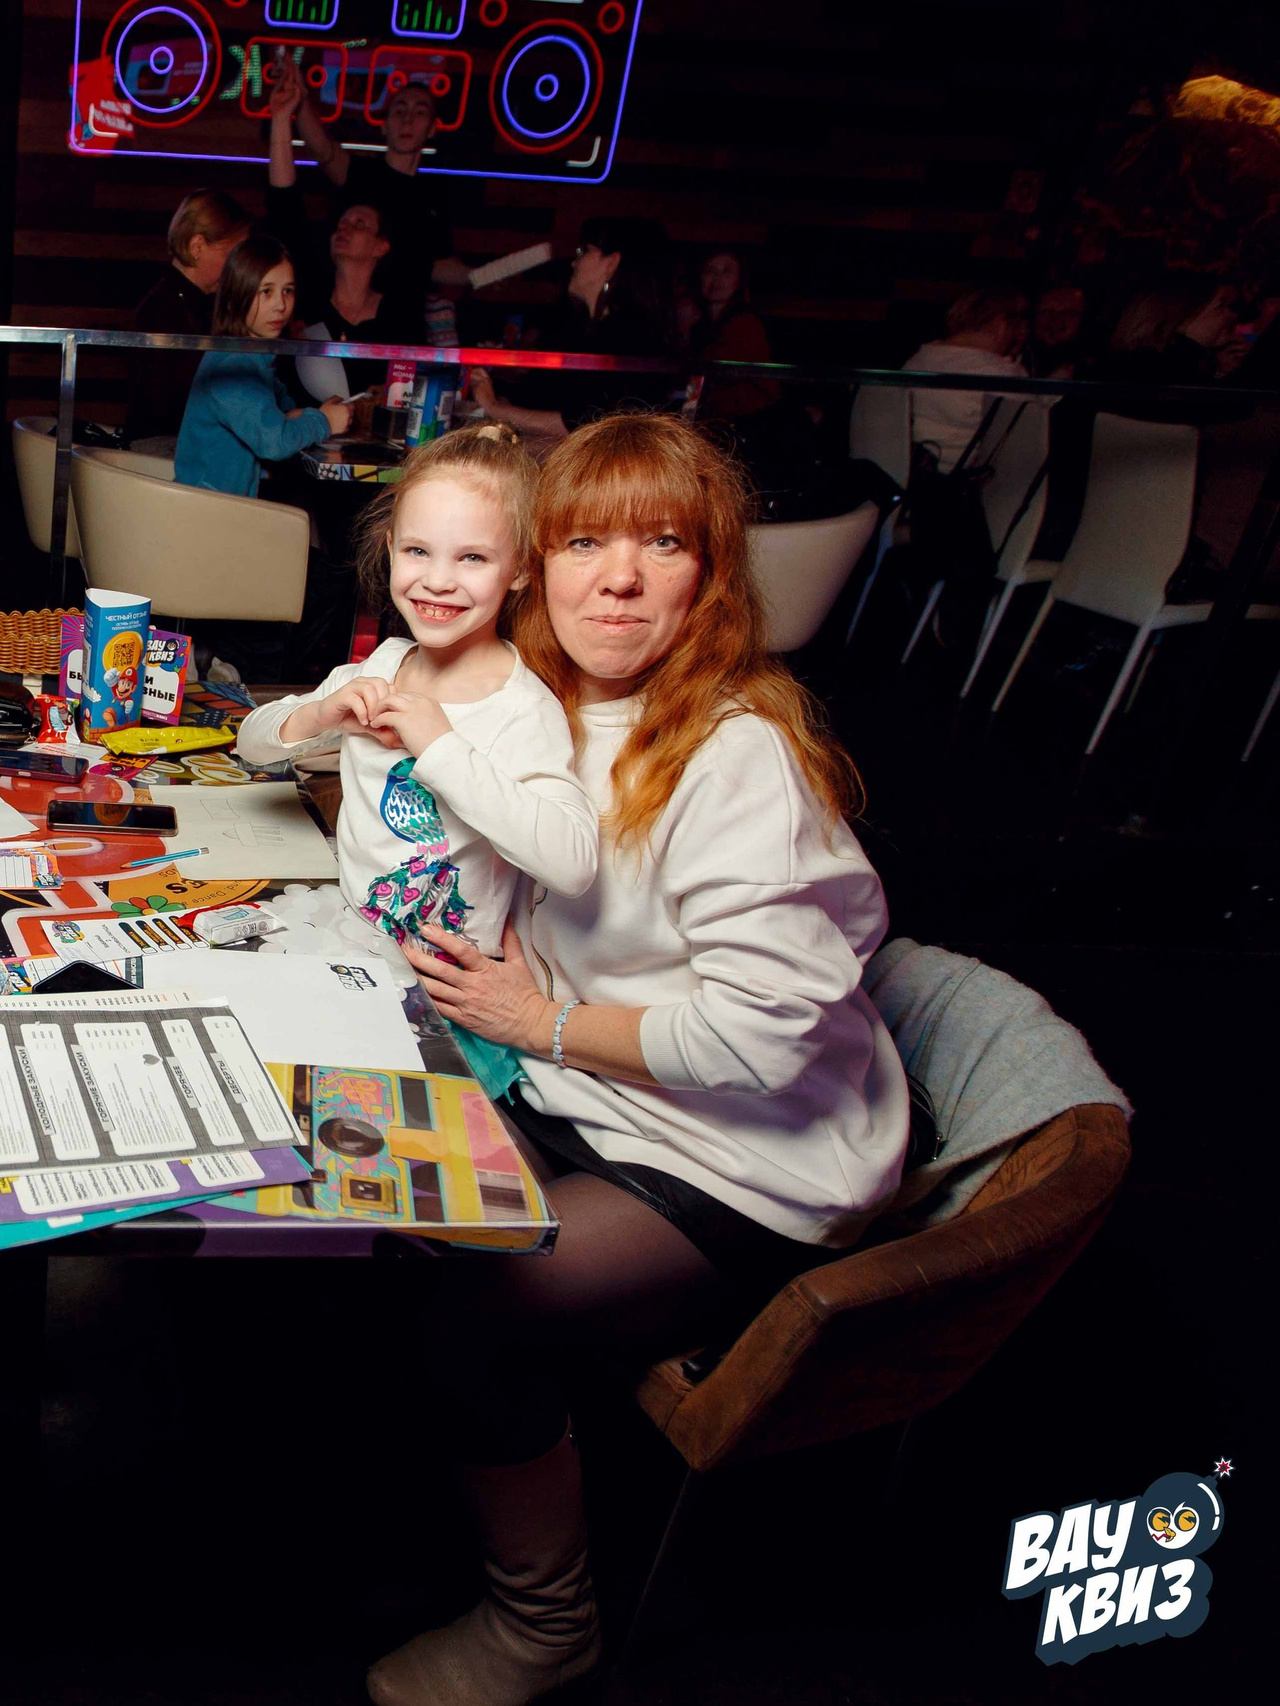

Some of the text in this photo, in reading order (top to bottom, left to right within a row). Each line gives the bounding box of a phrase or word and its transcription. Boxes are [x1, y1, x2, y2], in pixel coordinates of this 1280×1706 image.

[148, 651, 174, 662] КВИЗ
[143, 687, 176, 703] ЗНЫЕ
[192, 890, 226, 904] Dance
[18, 1048, 52, 1131] ХОЛОДНЫЕ ЗАКУСКИ
[76, 1051, 109, 1123] ГОРЯЧИЕ ЗАКУСКИ
[173, 1065, 193, 1099] ГОРЯЧЕЕ
[217, 1060, 241, 1095] ДЕСЕРТЫ
